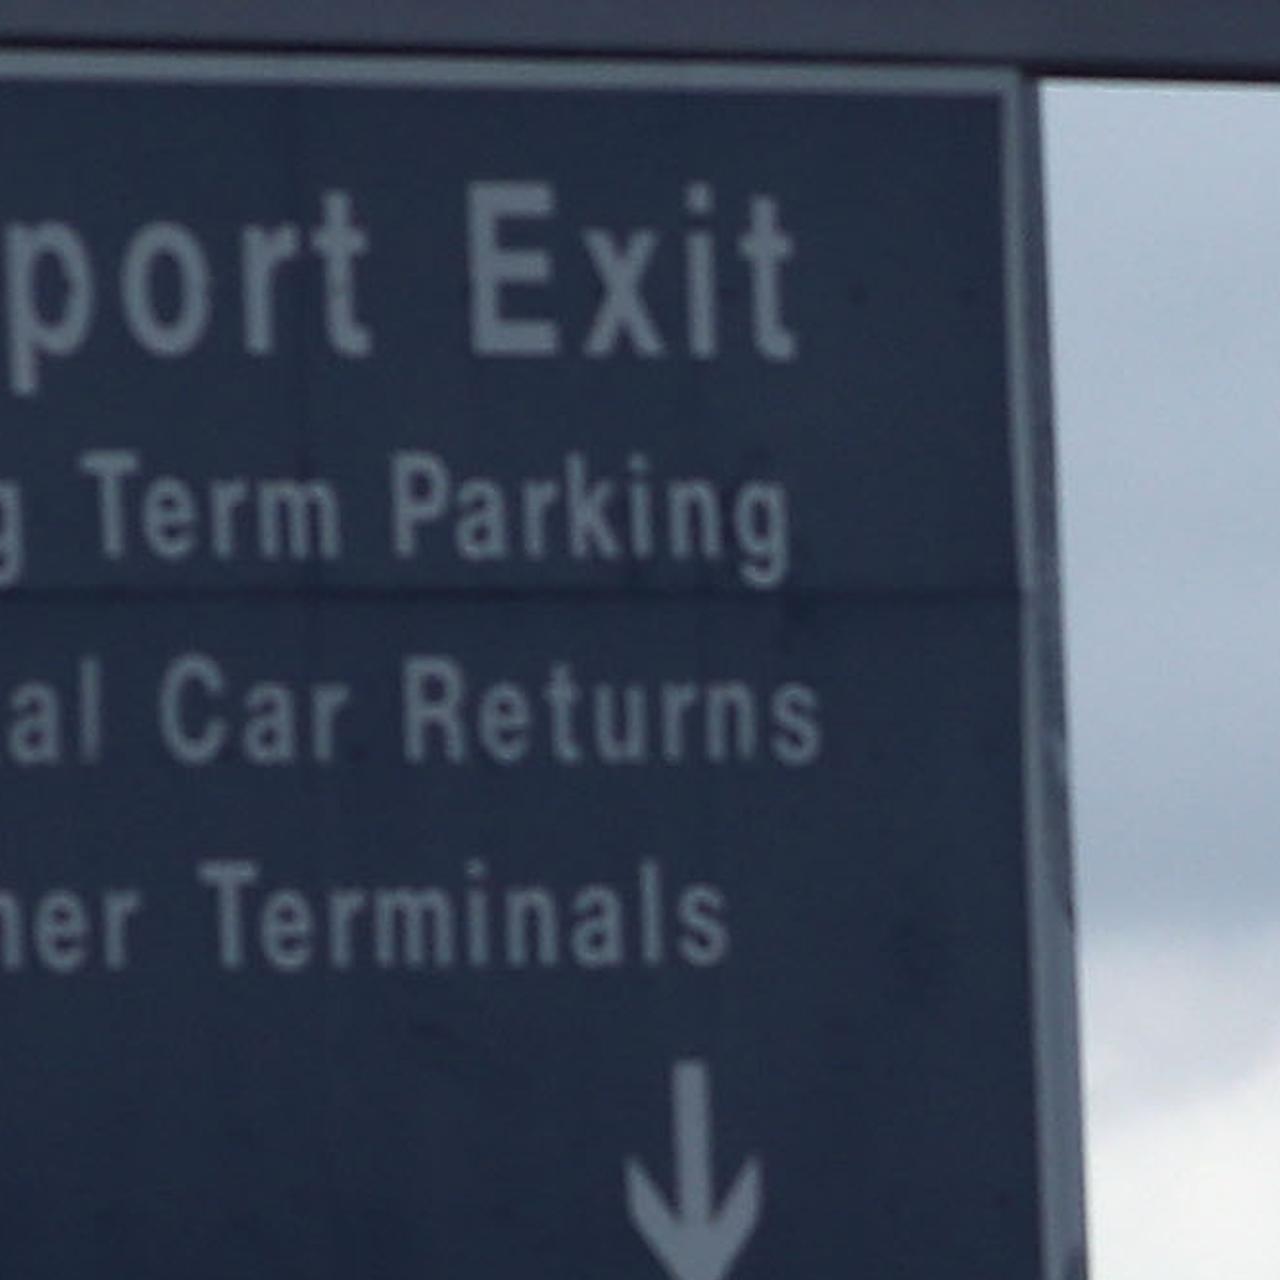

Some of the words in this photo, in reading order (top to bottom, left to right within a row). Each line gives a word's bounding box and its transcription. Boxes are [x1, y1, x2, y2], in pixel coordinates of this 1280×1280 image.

[467, 180, 798, 362] Exit
[78, 448, 342, 561] Term
[390, 449, 789, 589] Parking
[158, 652, 350, 766] Car
[401, 654, 821, 767] Returns
[196, 857, 730, 973] Terminals
